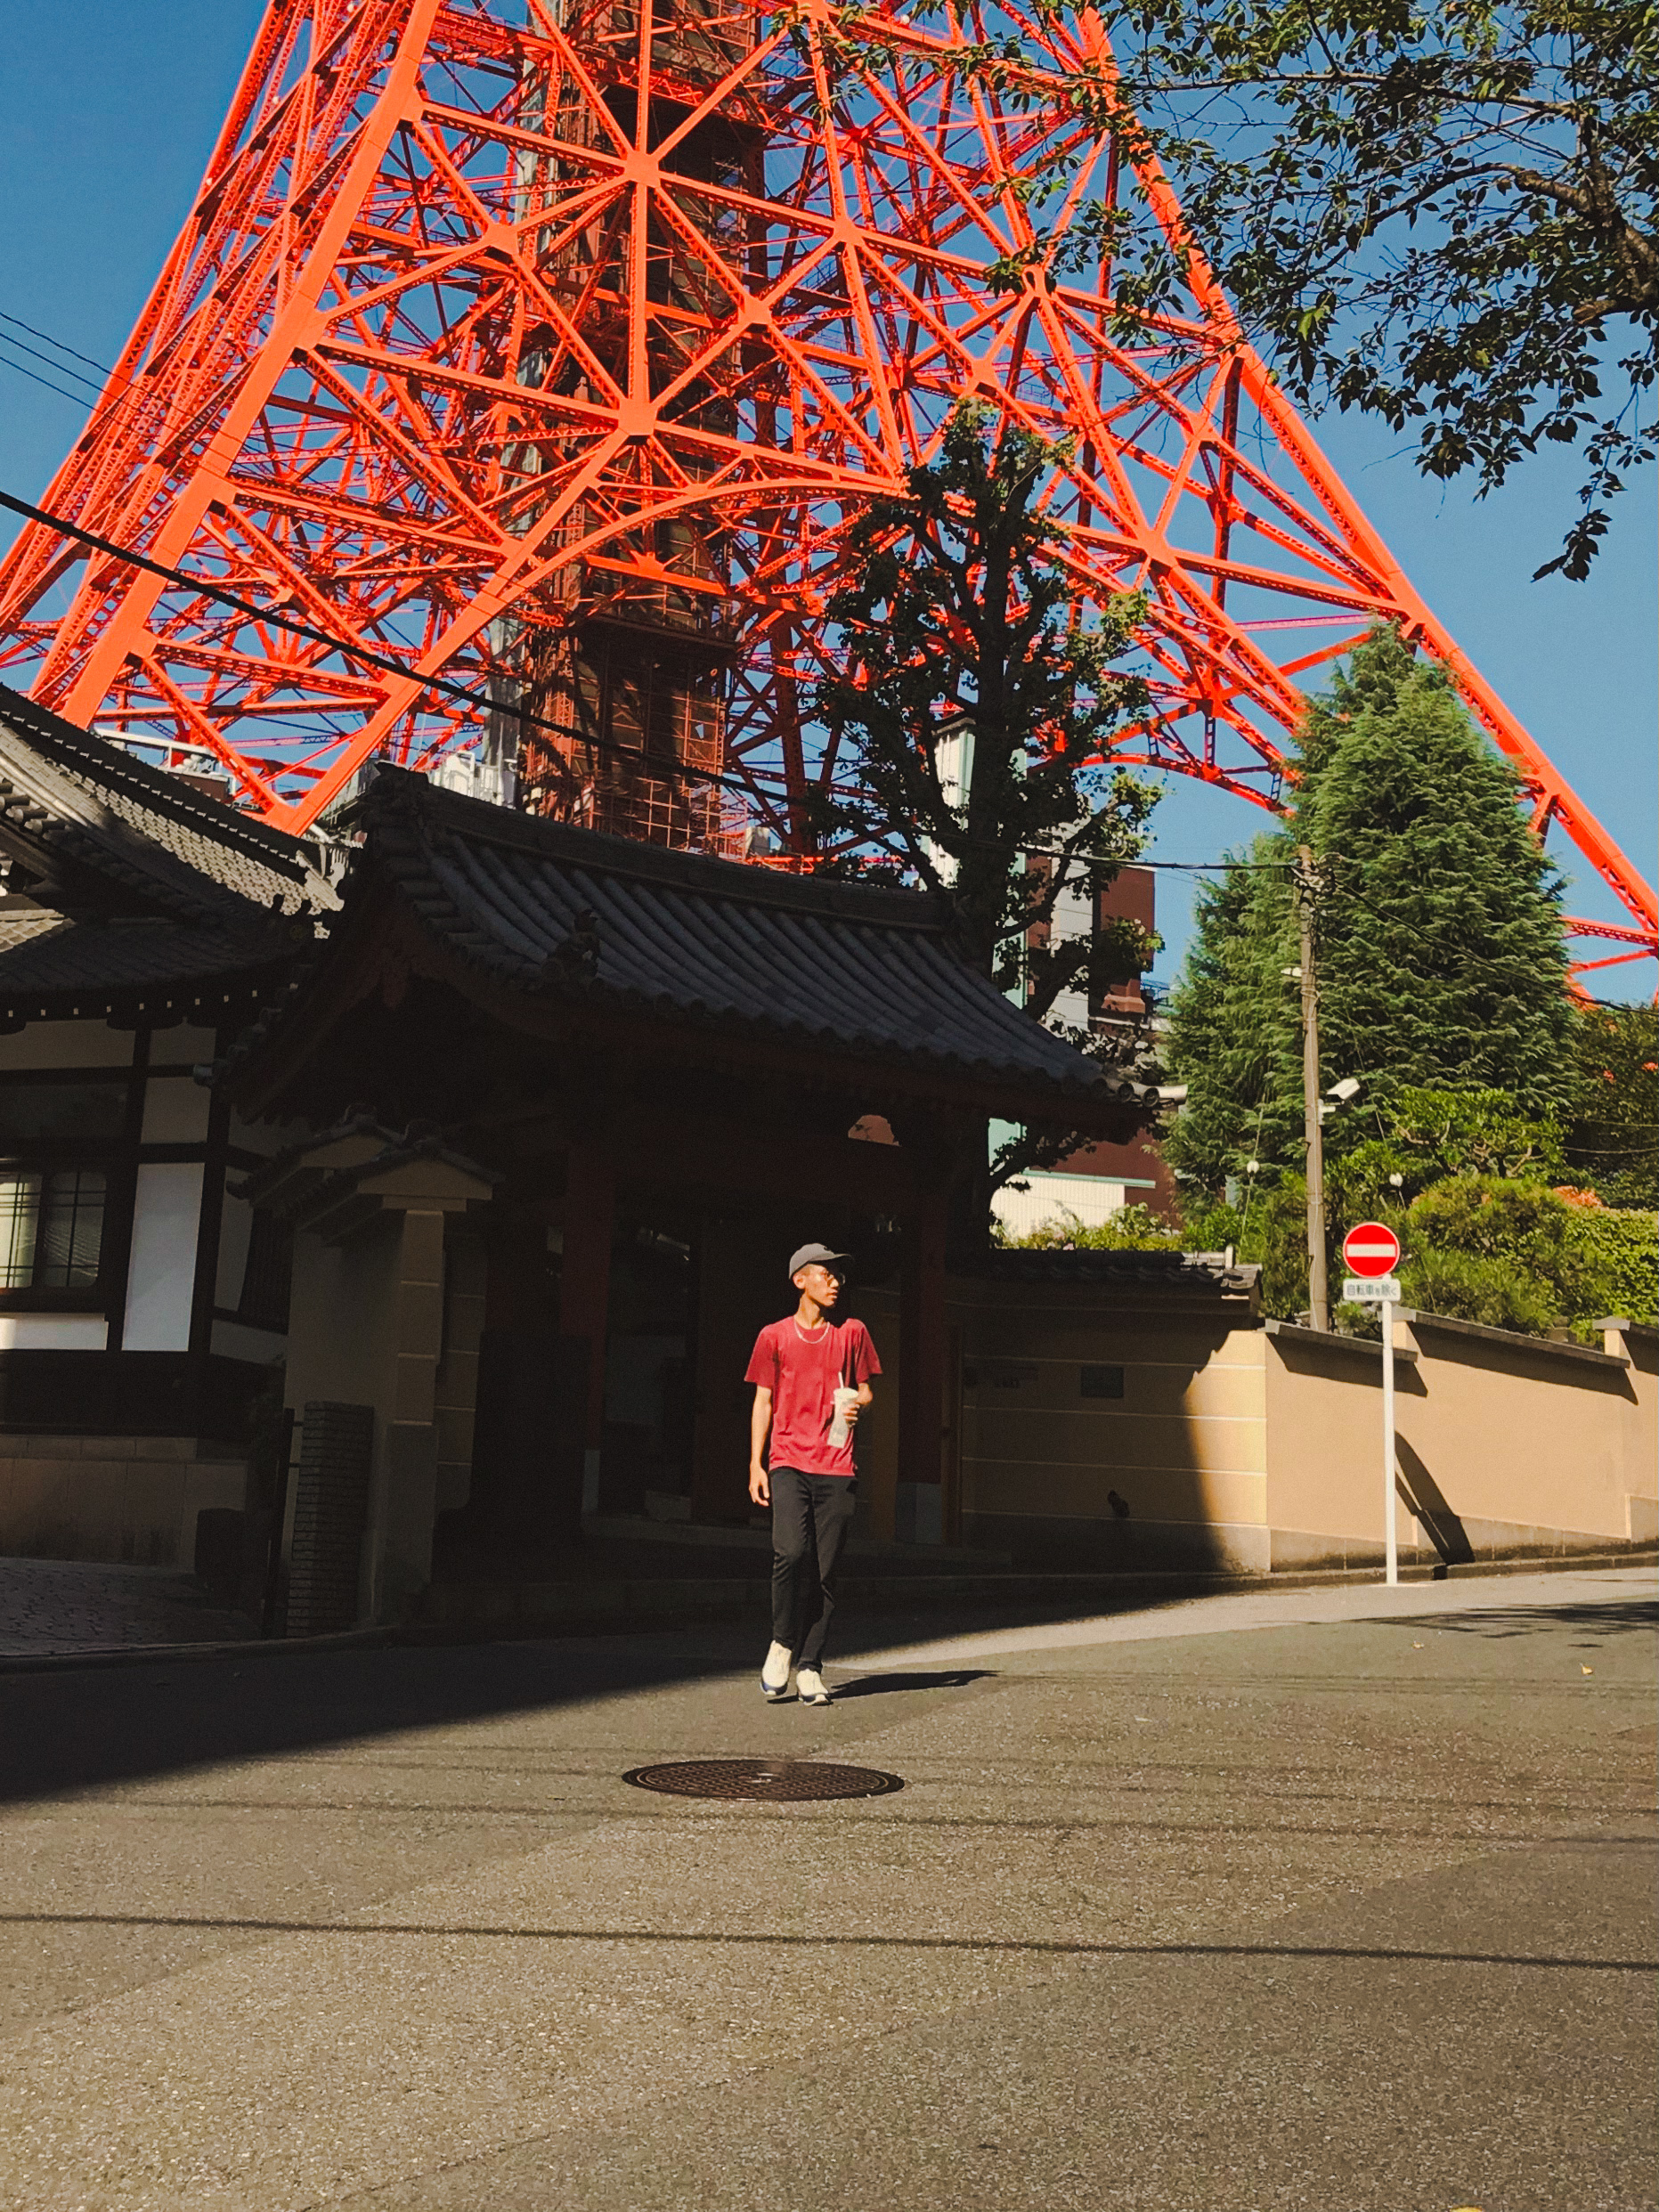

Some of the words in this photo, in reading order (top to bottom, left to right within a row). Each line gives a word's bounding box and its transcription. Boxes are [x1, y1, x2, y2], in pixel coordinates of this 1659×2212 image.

[1346, 1283, 1397, 1297] 自転車を除く
